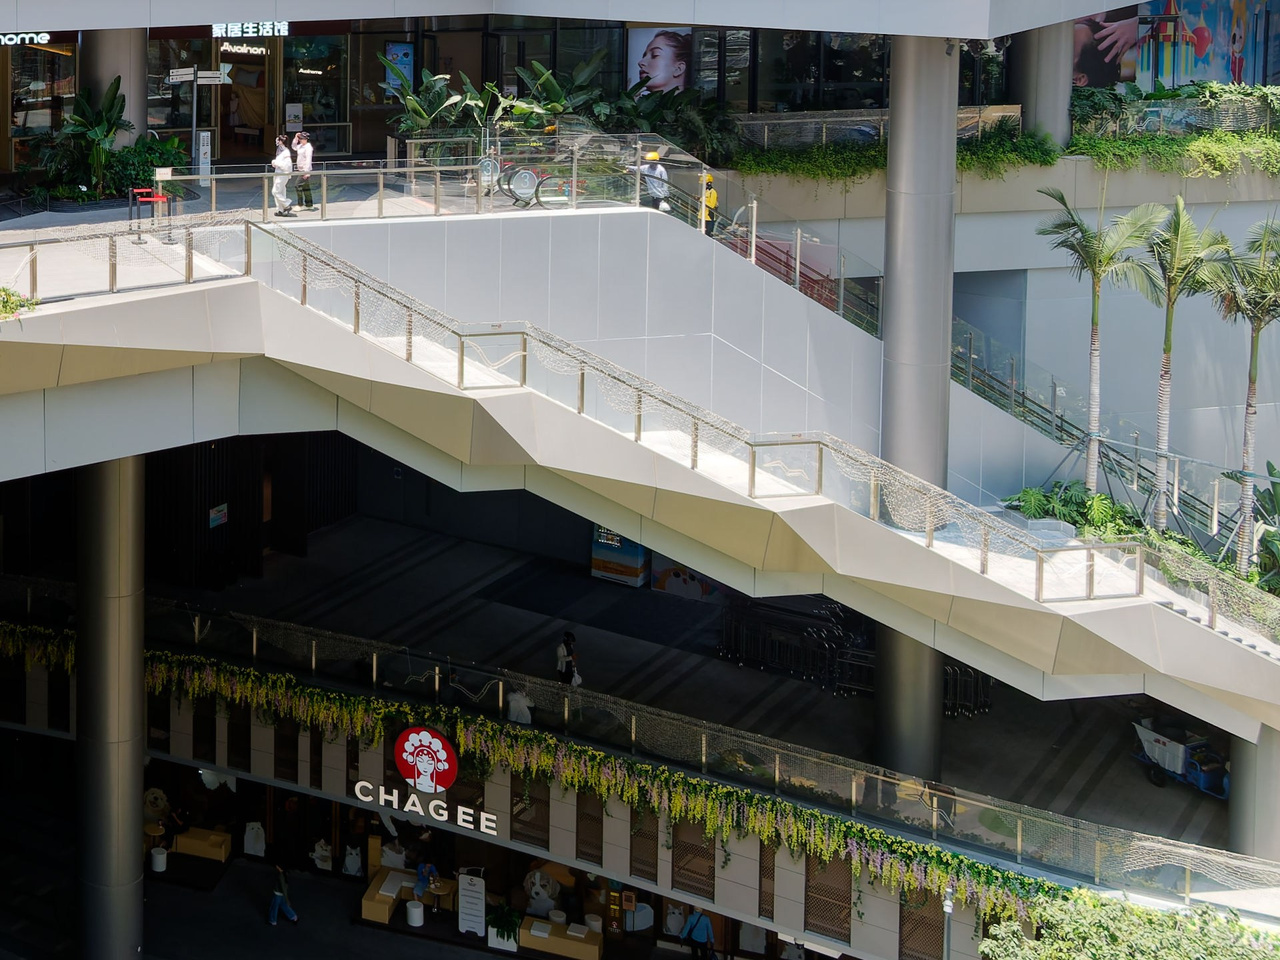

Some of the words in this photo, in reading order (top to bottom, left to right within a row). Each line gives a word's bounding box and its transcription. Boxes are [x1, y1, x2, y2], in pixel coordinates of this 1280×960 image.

[212, 21, 289, 38] 家居生活馆
[483, 161, 492, 176] 3
[521, 173, 531, 188] 3
[354, 780, 498, 836] CHAGEE
